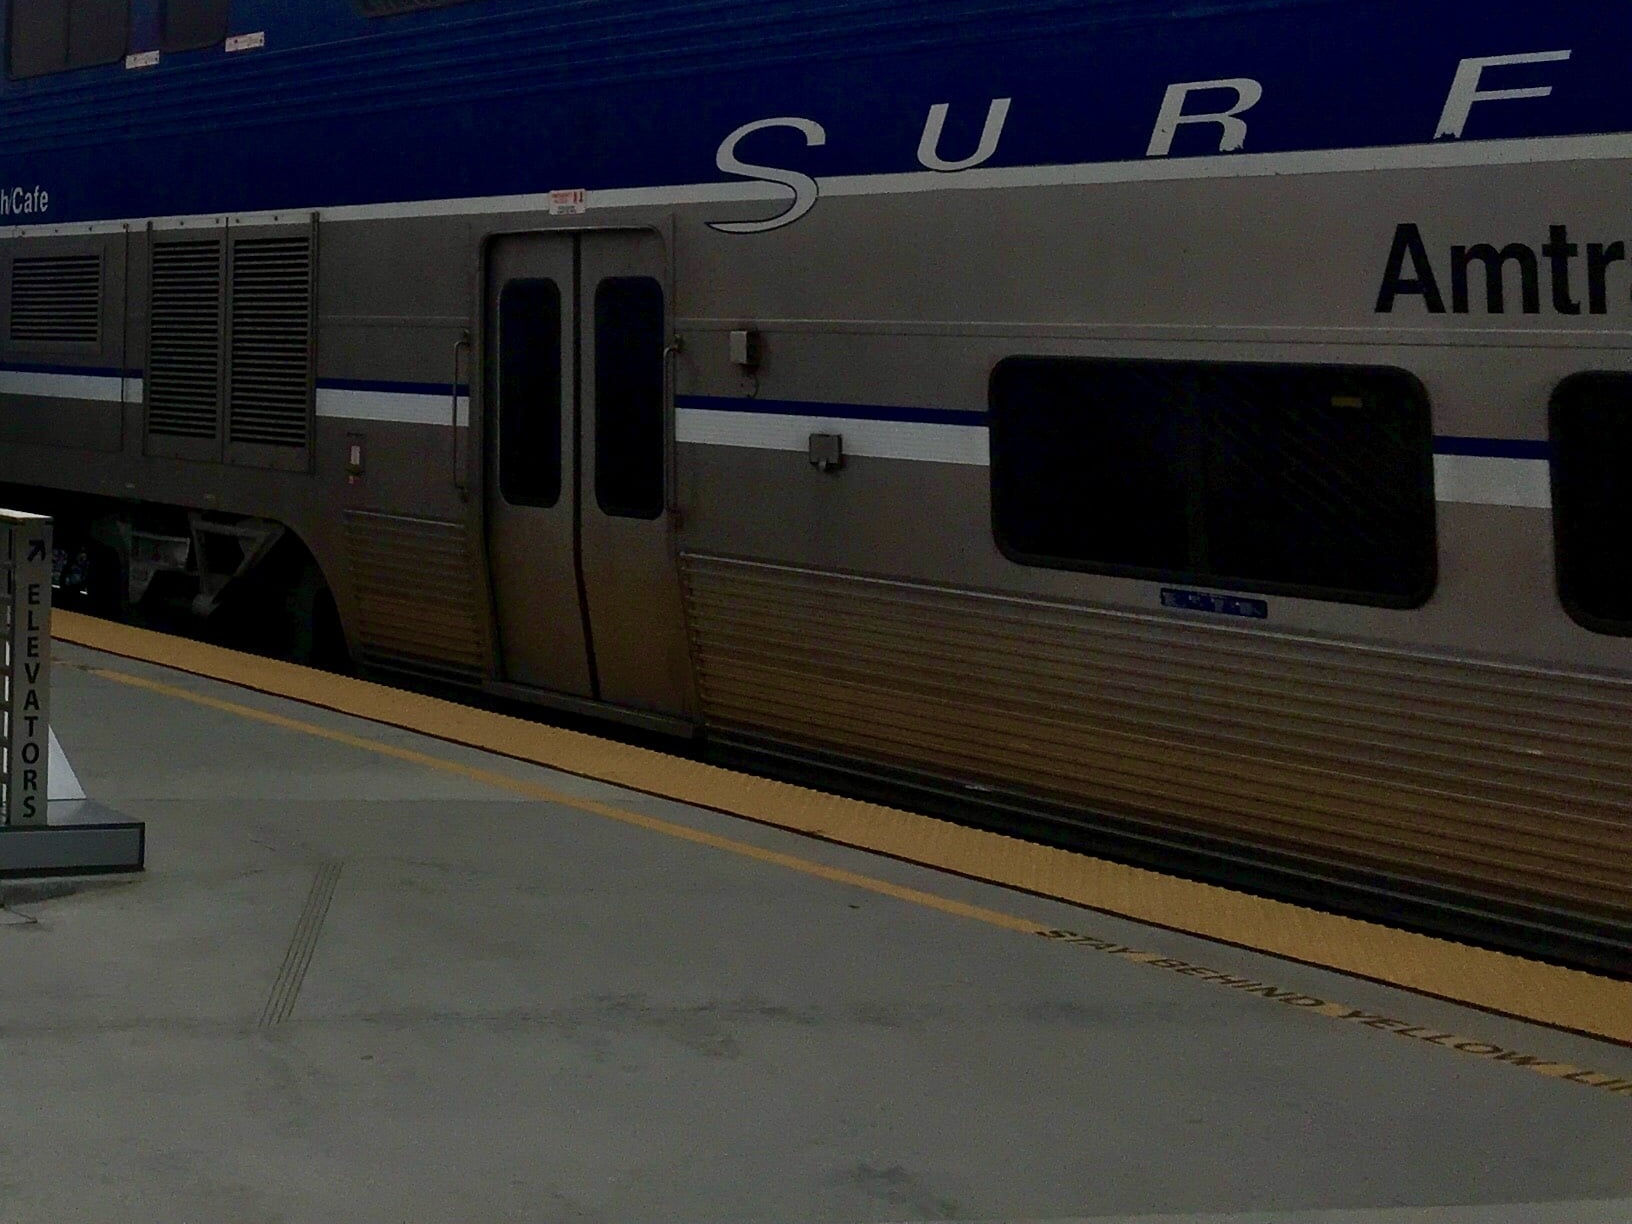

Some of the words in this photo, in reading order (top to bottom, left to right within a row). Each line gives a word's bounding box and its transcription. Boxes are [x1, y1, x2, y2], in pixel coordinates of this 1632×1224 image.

[1374, 222, 1626, 316] Amtr
[21, 583, 41, 818] ELEVATORS
[1036, 930, 1147, 954] STAY
[1145, 959, 1325, 1007] BEHIND
[1338, 1010, 1558, 1066] YELLOW
